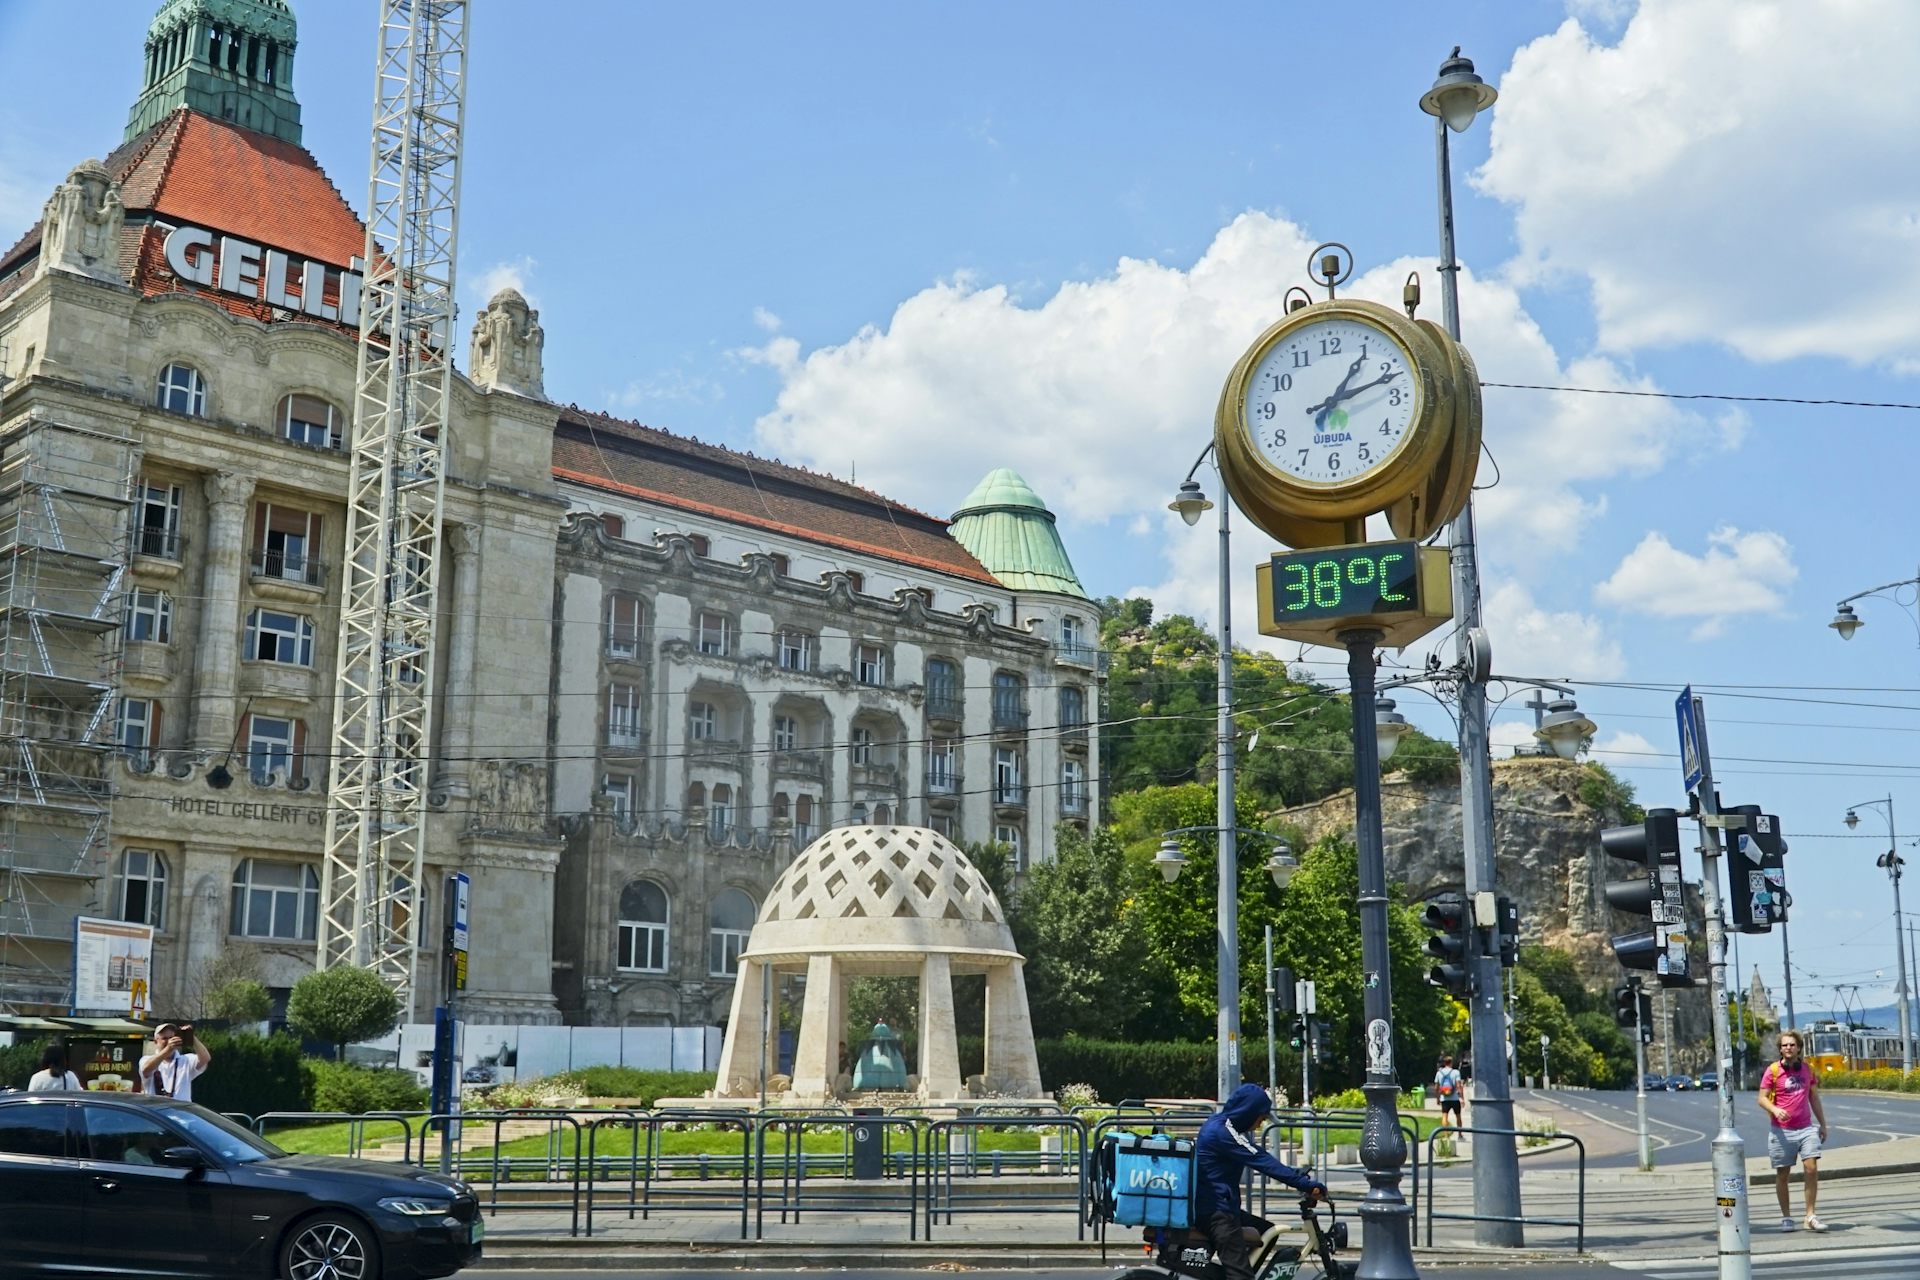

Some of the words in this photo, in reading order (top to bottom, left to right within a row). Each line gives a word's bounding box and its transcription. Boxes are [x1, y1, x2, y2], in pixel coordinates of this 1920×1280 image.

[1319, 337, 1342, 357] 12
[1359, 344, 1369, 361] 1
[1291, 350, 1311, 368] 11
[1380, 362, 1393, 377] 2
[1272, 373, 1292, 392] 10
[1389, 388, 1401, 406] 3
[1264, 402, 1276, 420] 9
[1379, 418, 1391, 436] 4
[1274, 429, 1287, 447] 8
[1313, 432, 1352, 444] ÚJBUDA
[1298, 448, 1310, 466] 7
[1358, 442, 1370, 460] 5
[1328, 452, 1340, 470] 6
[172, 795, 224, 816] HOTEL
[232, 803, 300, 824] GELLÉRT
[1129, 1168, 1178, 1190] Wolt
